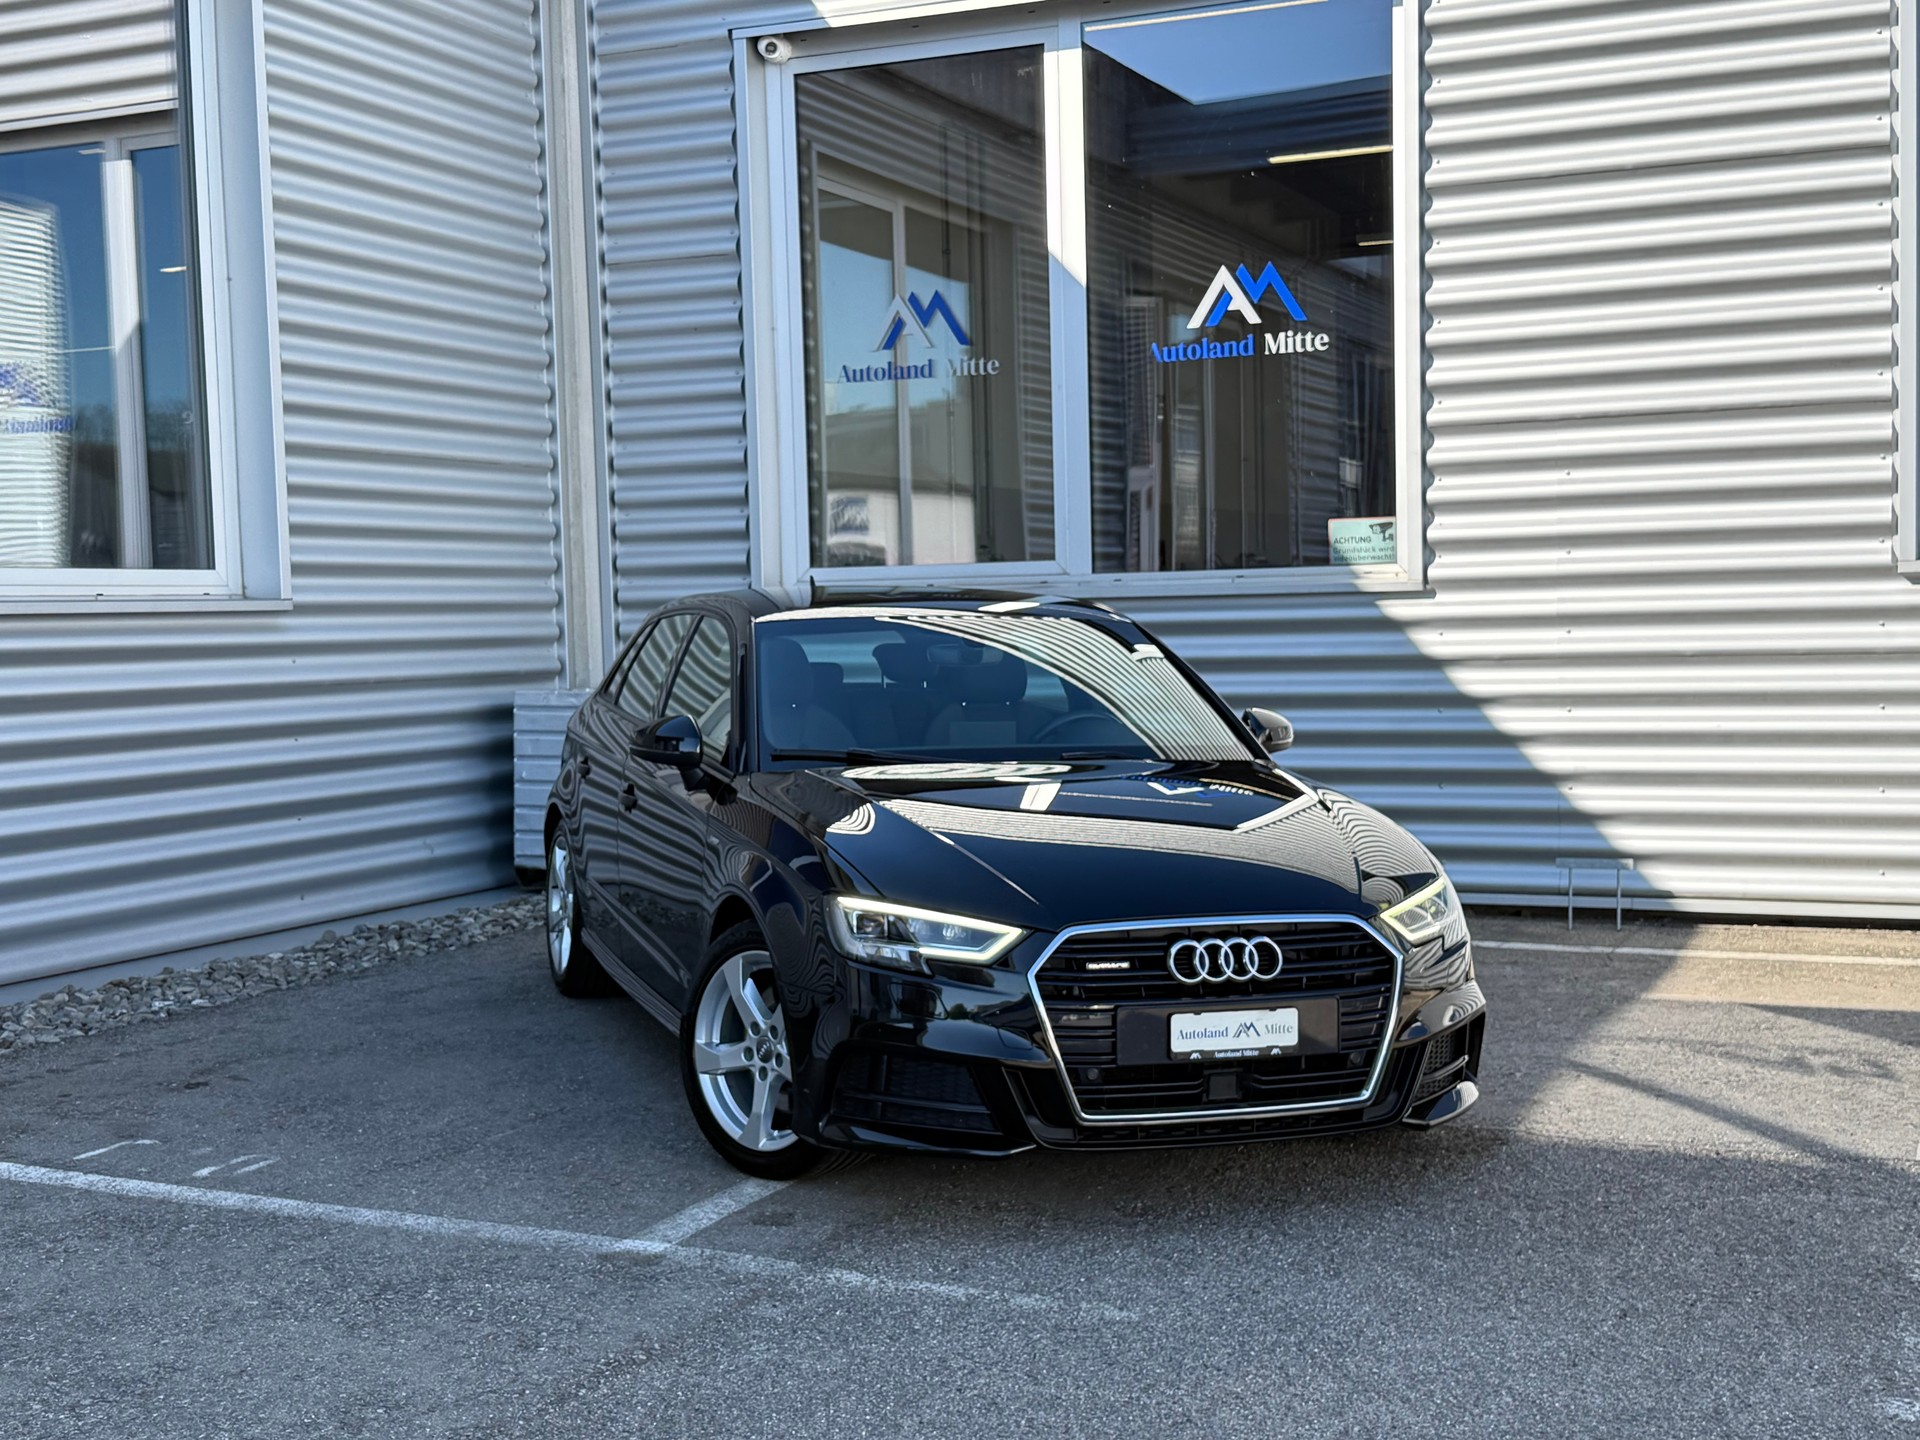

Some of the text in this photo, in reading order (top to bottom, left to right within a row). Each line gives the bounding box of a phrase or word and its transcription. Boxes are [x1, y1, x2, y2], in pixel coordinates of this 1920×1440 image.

[1151, 330, 1330, 363] Autoland Mitte
[837, 358, 933, 384] Autoland
[1333, 535, 1372, 544] ACHTUNG
[1378, 545, 1395, 553] wird
[1177, 1026, 1229, 1040] Autoland
[1264, 1022, 1293, 1035] Mitte
